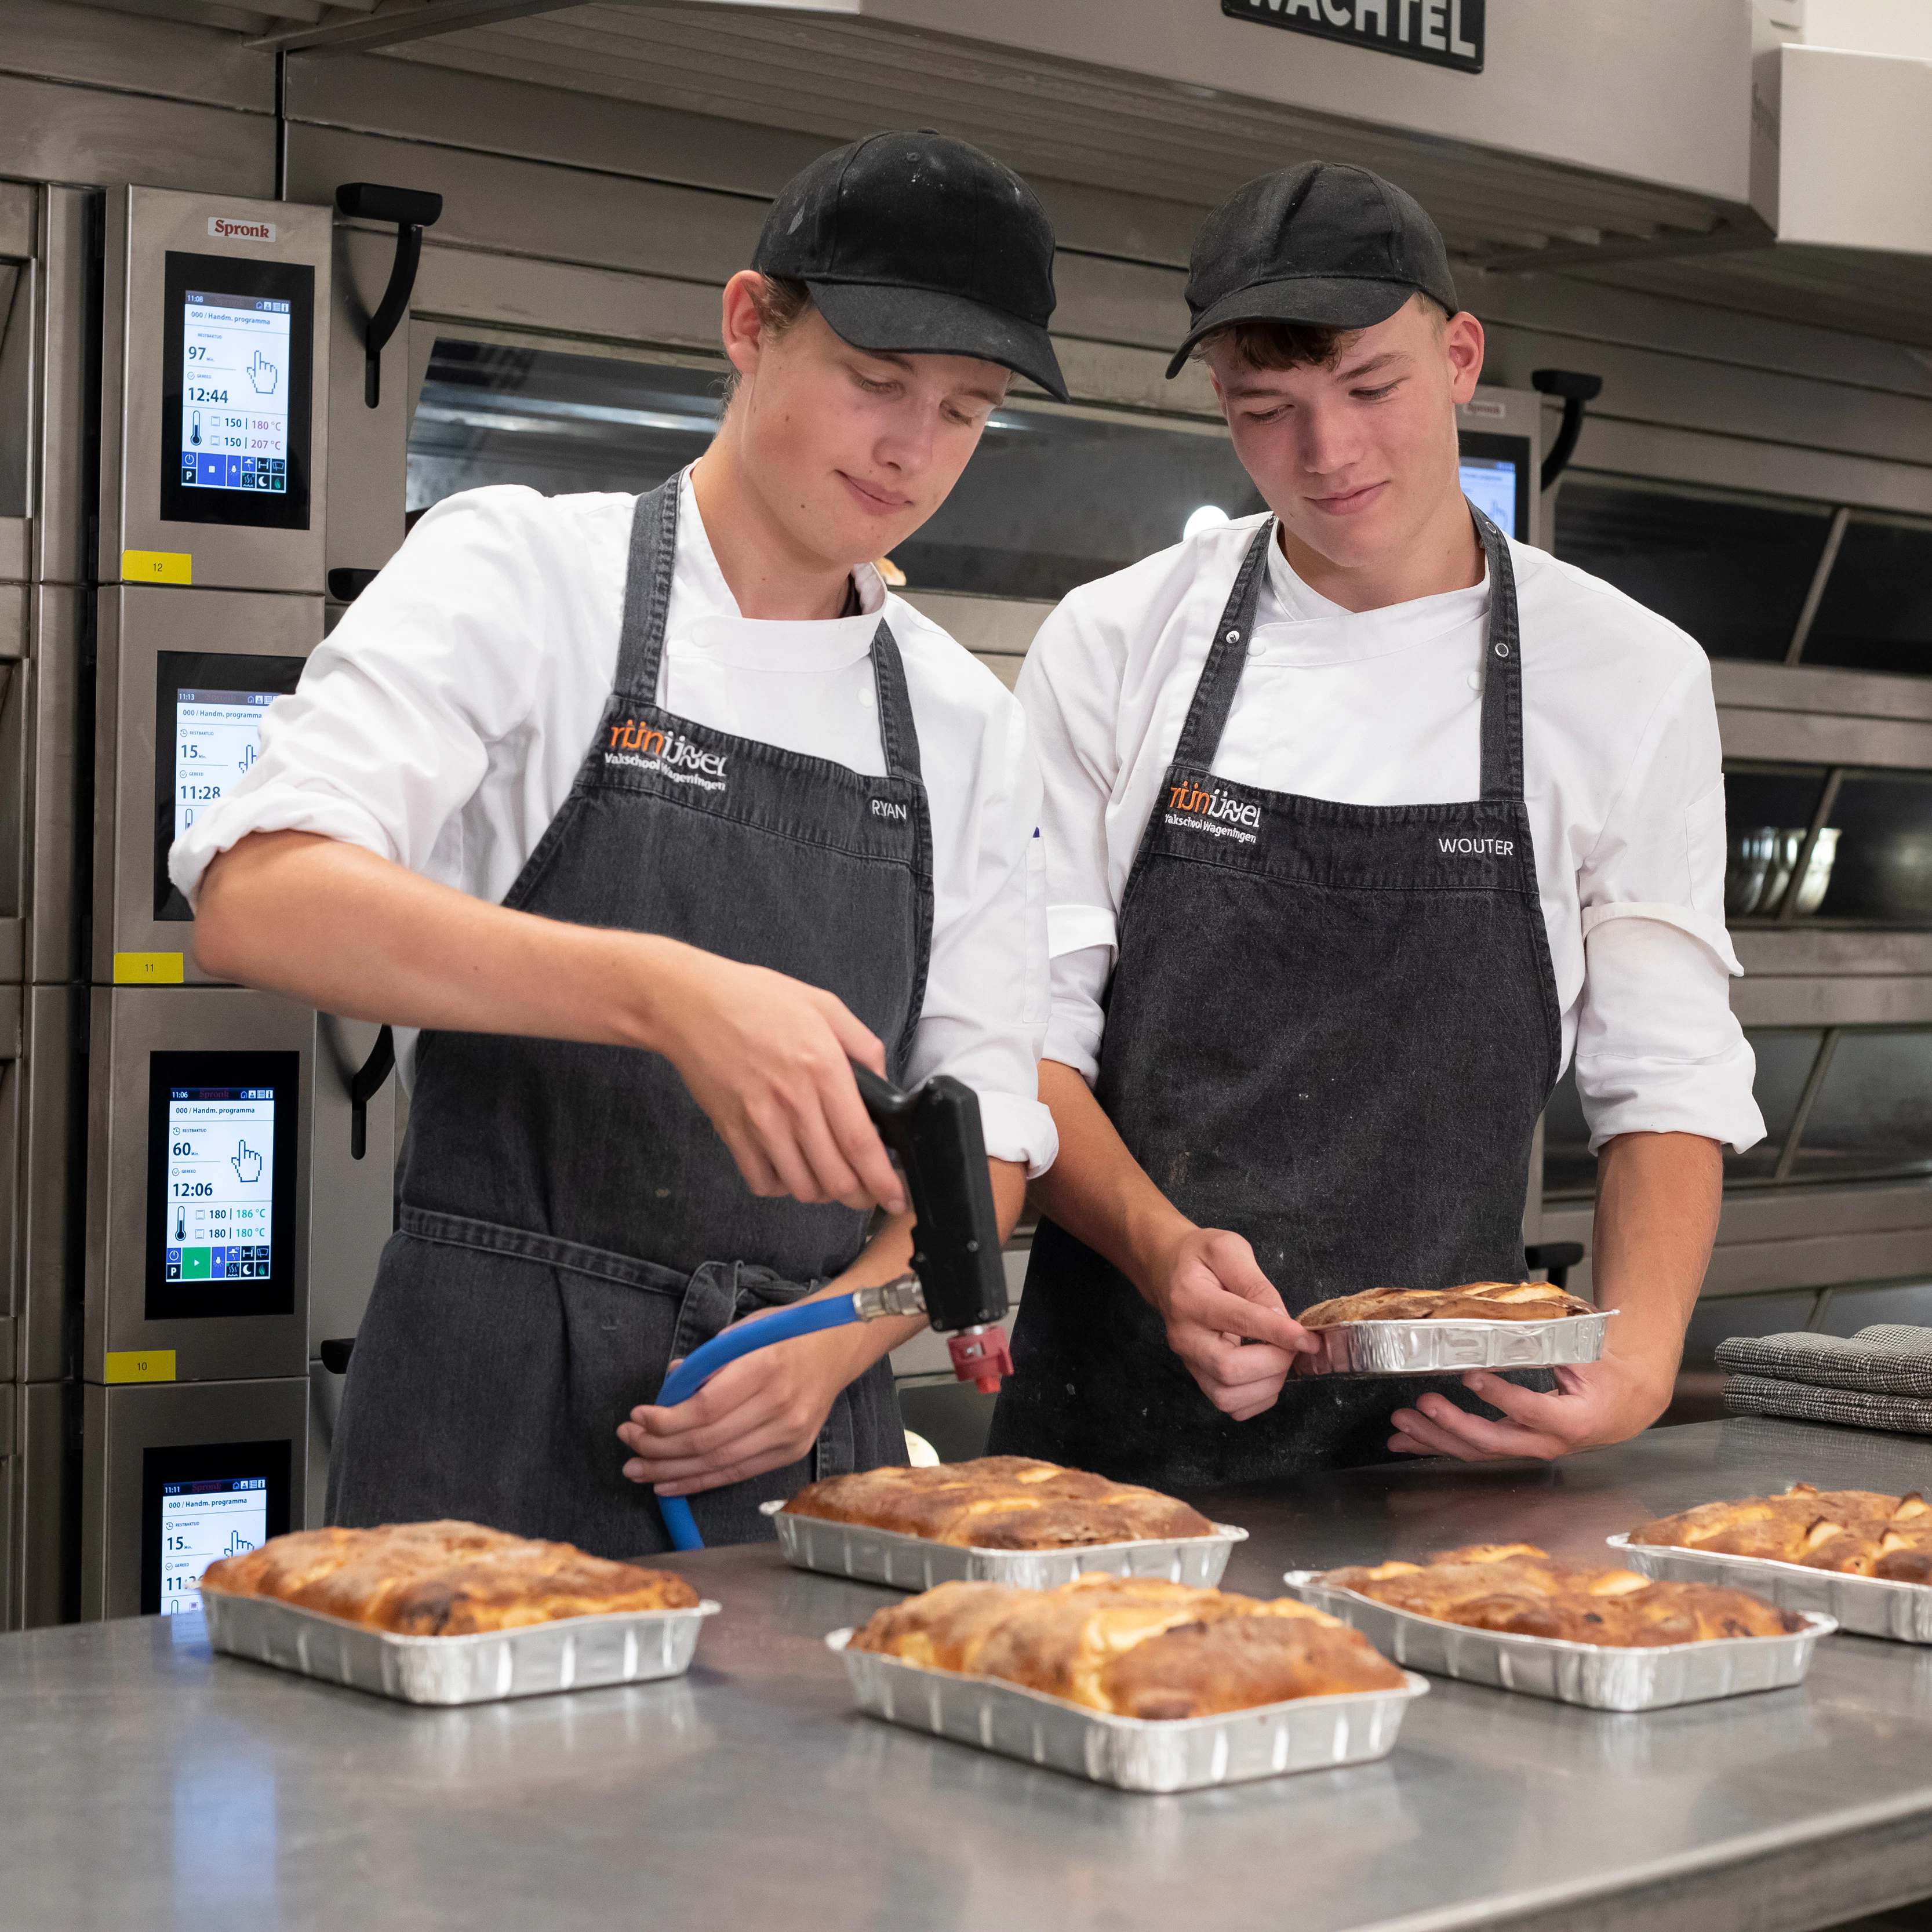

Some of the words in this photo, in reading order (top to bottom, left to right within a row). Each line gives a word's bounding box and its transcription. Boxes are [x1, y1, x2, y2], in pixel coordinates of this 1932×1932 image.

[1249, 0, 1476, 58] CHTEL
[214, 220, 269, 238] Spronk
[187, 294, 203, 303] 11:08
[209, 313, 233, 321] Handm.
[234, 316, 270, 325] programma
[188, 346, 206, 360] 97
[188, 387, 228, 403] 12:44
[225, 418, 242, 427] 150
[252, 420, 268, 430] 180
[224, 437, 241, 447] 150
[252, 439, 268, 449] 207
[153, 563, 163, 572] 12
[226, 711, 262, 719] programma
[181, 745, 198, 758] 15
[605, 752, 660, 770] Vakschool
[661, 762, 726, 791] Wageningen
[181, 785, 220, 799] 11:28
[872, 800, 907, 820] RYAN
[1203, 821, 1256, 843] Wageningen
[1438, 838, 1513, 856] WOUTER
[145, 963, 154, 972] 11
[173, 1143, 191, 1156] 60
[173, 1183, 213, 1196] 12:06
[209, 1210, 226, 1218] 180
[237, 1209, 253, 1218] 186
[209, 1229, 226, 1238] 180
[237, 1228, 253, 1238] 180
[171, 1268, 177, 1276] P
[137, 1362, 147, 1371] 10
[212, 1498, 247, 1507] programma
[167, 1536, 184, 1551] 15
[166, 1575, 204, 1591] 11:
